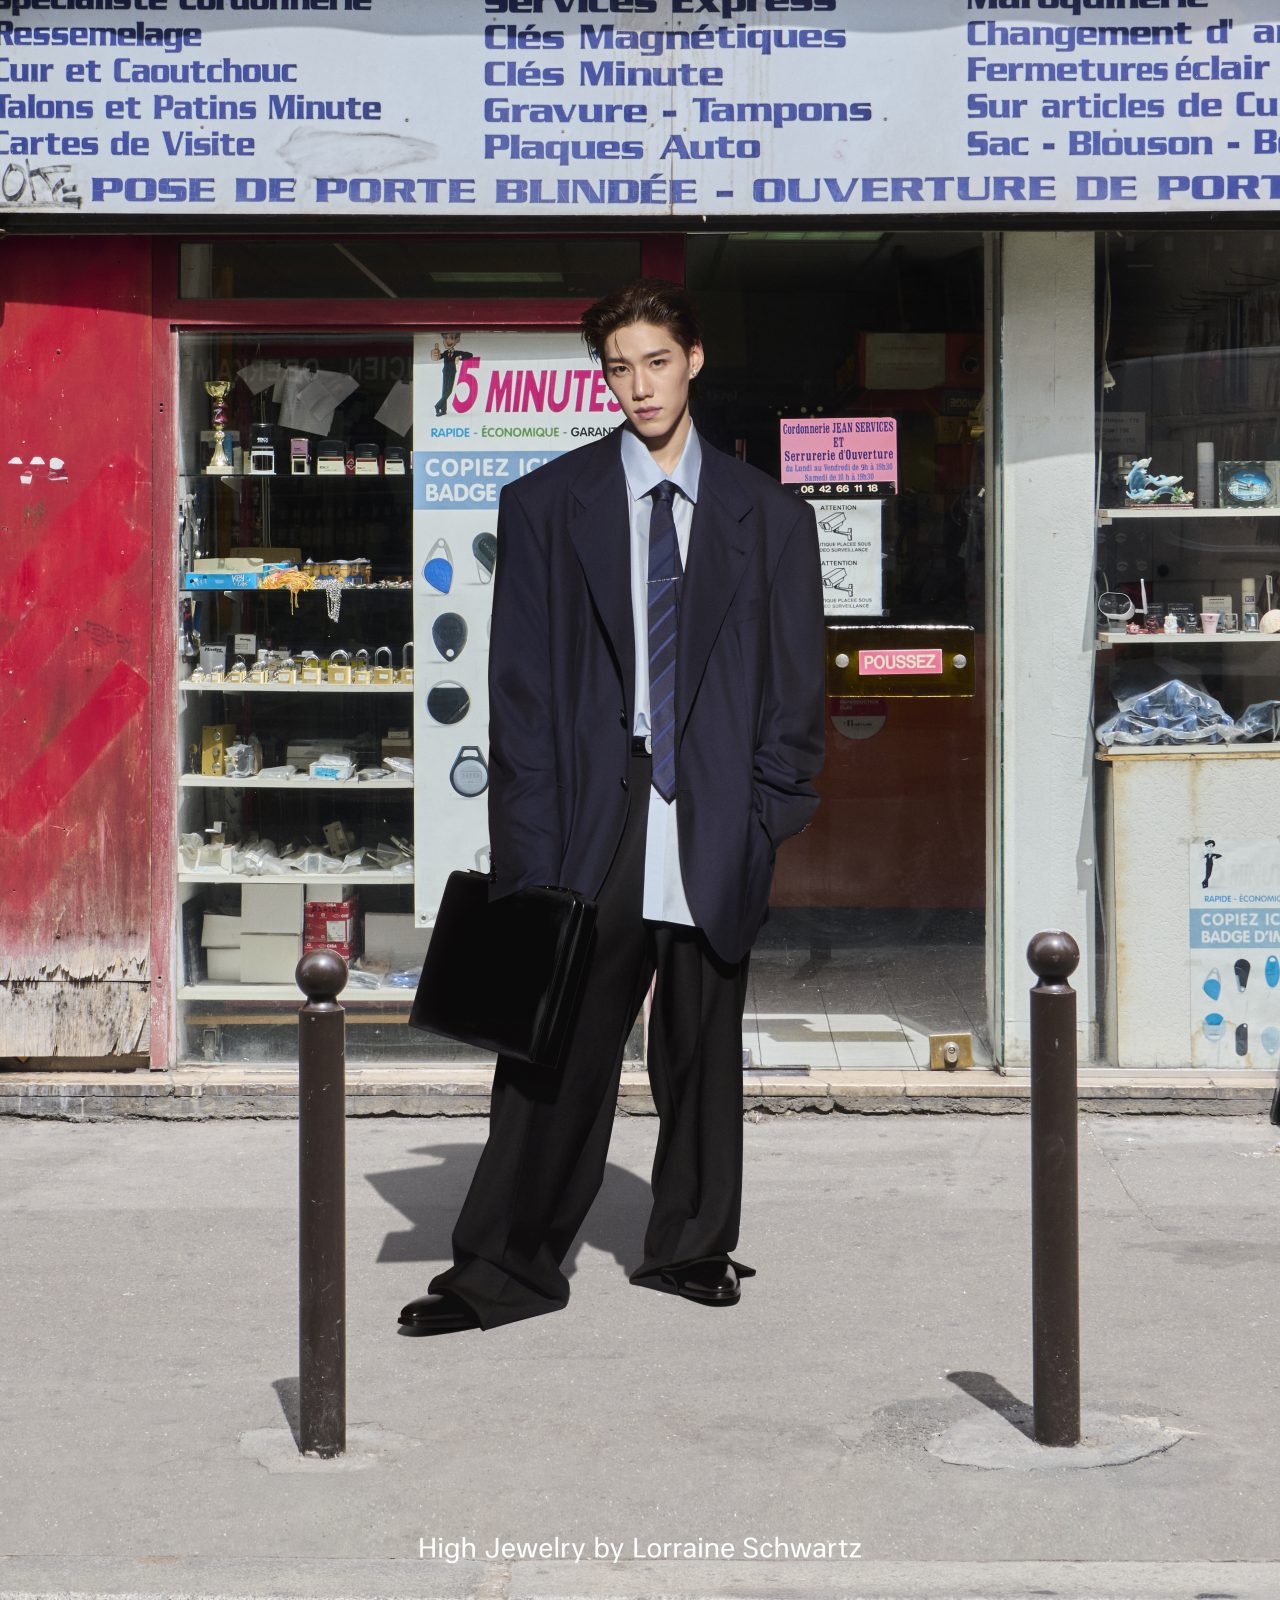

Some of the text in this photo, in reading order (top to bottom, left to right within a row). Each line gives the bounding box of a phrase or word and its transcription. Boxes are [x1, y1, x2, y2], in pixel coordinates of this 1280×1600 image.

[0, 21, 201, 53] Ressemelage
[485, 24, 846, 56] Clés Magnétiques
[967, 19, 1280, 52] Changement d' a
[66, 60, 101, 82] et
[114, 57, 297, 83] Caoutchouc
[485, 61, 723, 86] Clés Minute
[967, 55, 1270, 82] Fermetures éclair
[0, 94, 381, 120] Talons et Patins Minute
[485, 98, 647, 123] Gravure
[693, 98, 872, 128] Tampons
[967, 91, 1280, 118] Sur articles de Cu
[0, 130, 255, 156] Cartes de Visite
[485, 134, 760, 166] Plaques Auto
[967, 129, 1280, 156] Sac - Blouson - B
[91, 177, 215, 202] POSE
[235, 177, 296, 203] DE
[316, 178, 476, 203] PORTE
[496, 173, 698, 204] BLINDÉE
[753, 176, 1056, 203] OUVERTURE
[1077, 176, 1138, 201] DE
[451, 356, 481, 414] 5
[431, 427, 470, 438] RAPIDE
[481, 425, 560, 438] ÉCONOMIQUE
[783, 421, 894, 434] Cordonnerie JEAN SERVICES
[833, 437, 844, 448] ET
[425, 458, 509, 477] COPIEZ
[784, 449, 894, 462] Serrurerie d'Ouverture
[795, 464, 813, 472] Lundi
[805, 473, 828, 481] Samedi
[829, 473, 837, 481] de
[836, 485, 849, 493] 66
[854, 485, 863, 493] 11
[867, 484, 879, 492] 18
[425, 483, 497, 502] BADGE
[864, 654, 936, 669] POUSSEZ
[1204, 895, 1232, 903] RAPIDE
[1201, 913, 1259, 926] COPIEZ
[1201, 930, 1251, 943] BADGE
